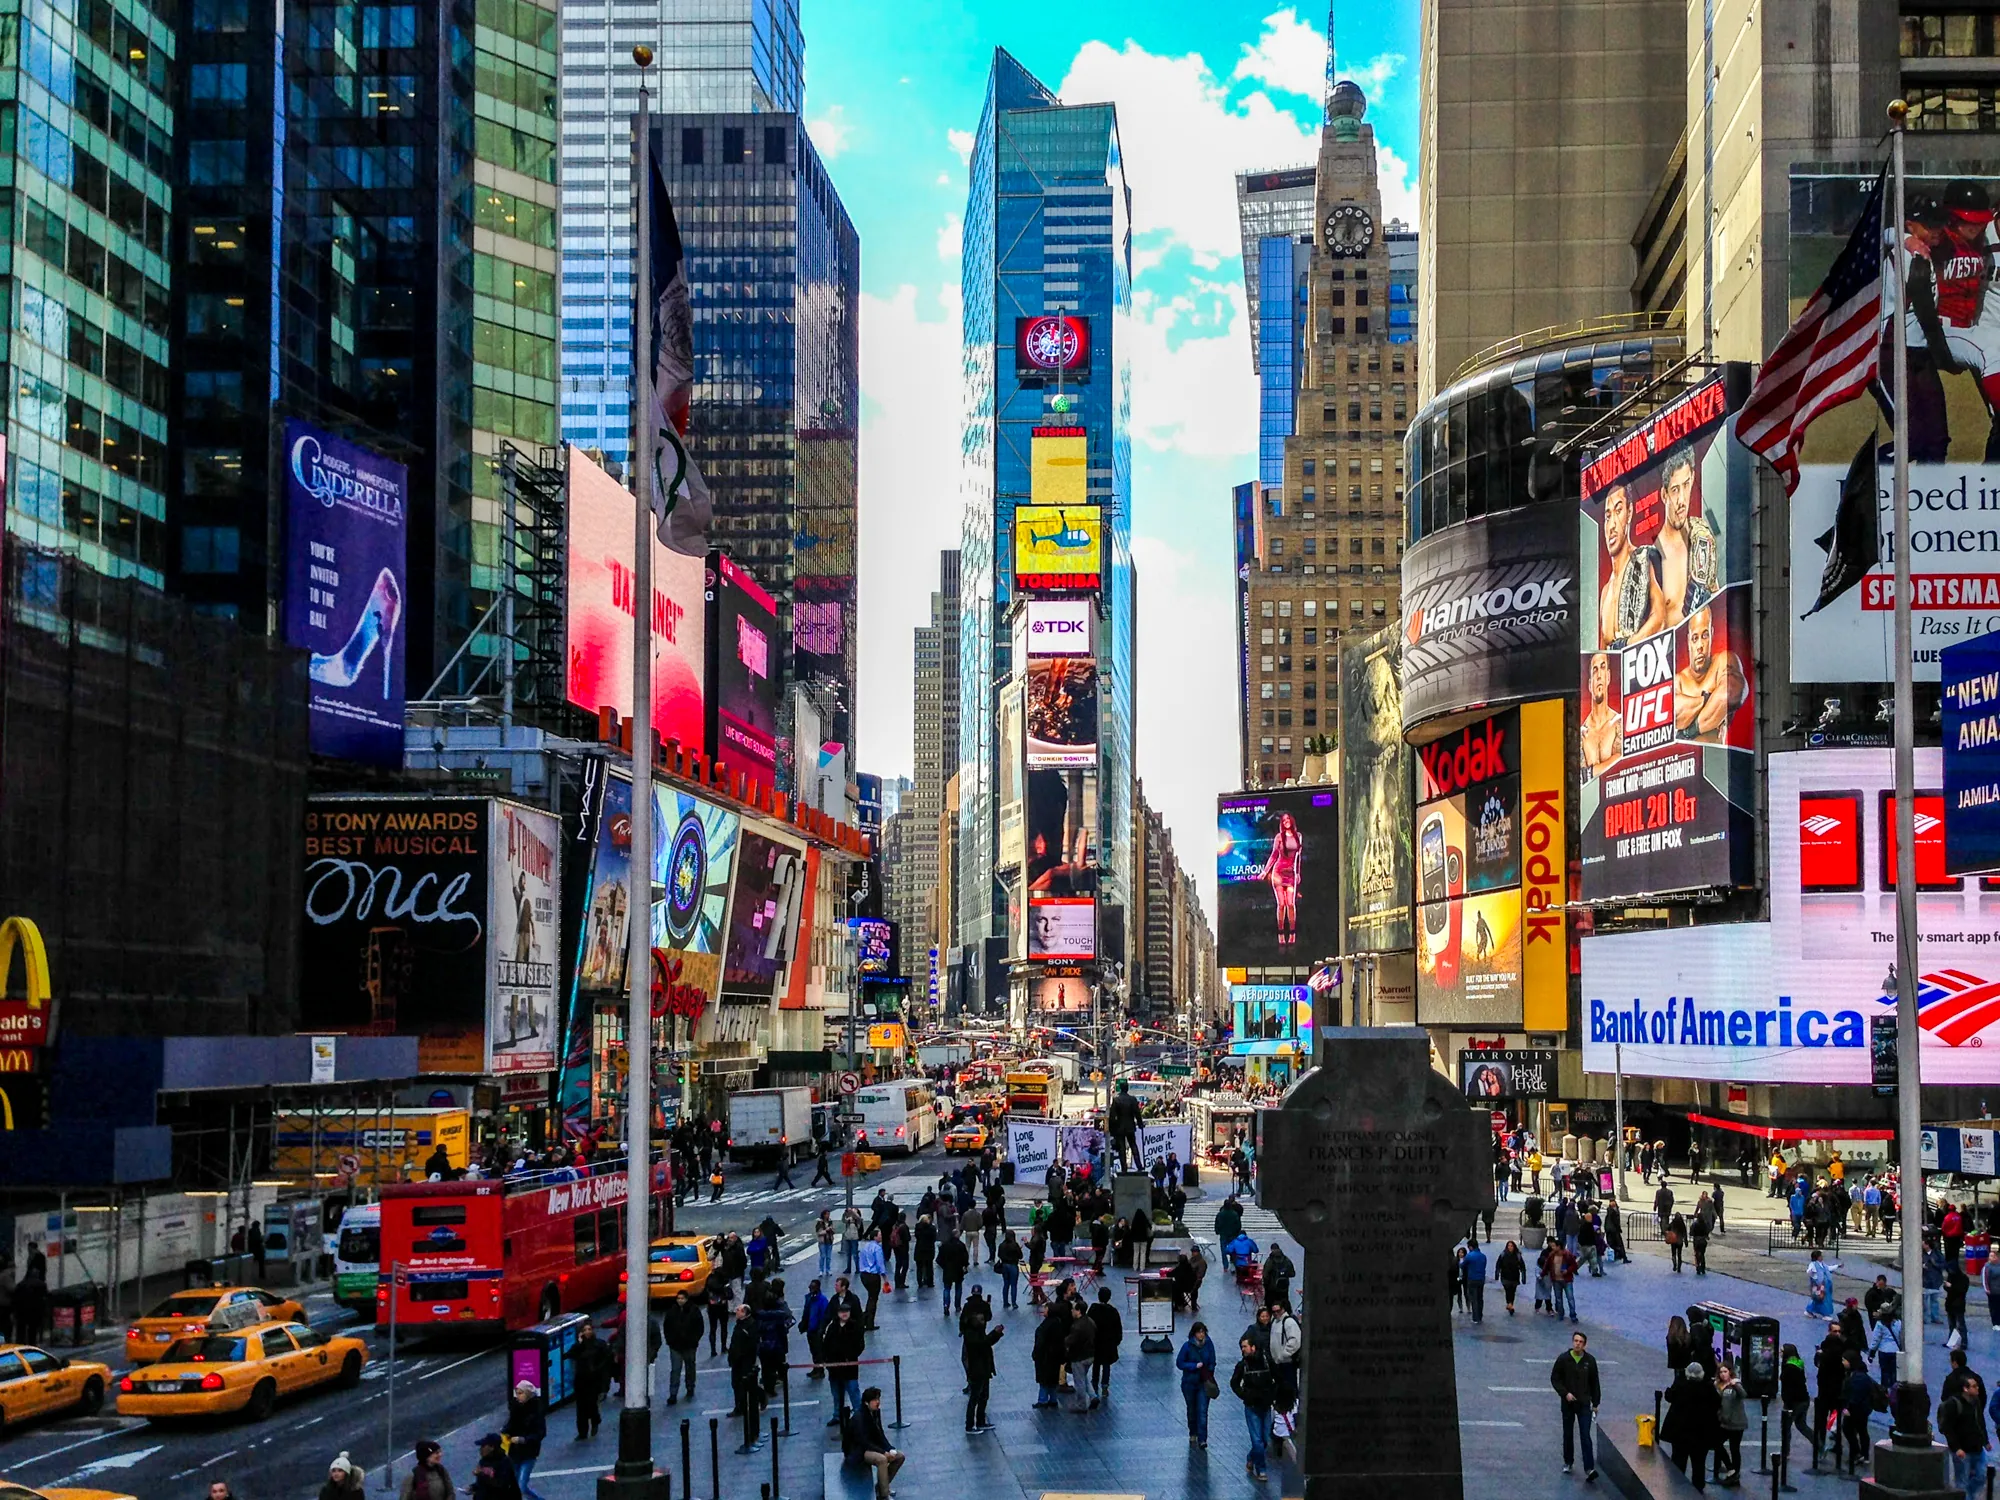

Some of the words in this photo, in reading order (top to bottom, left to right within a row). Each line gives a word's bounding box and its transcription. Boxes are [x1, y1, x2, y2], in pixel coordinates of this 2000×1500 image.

[1032, 427, 1086, 437] TOSHIBA
[291, 435, 403, 521] CINDERELLA
[310, 564, 339, 587] INVITED
[1015, 574, 1099, 589] TOSHIBA
[310, 587, 320, 605] TO
[309, 610, 327, 631] BALL
[1049, 620, 1084, 633] TDK
[1437, 621, 1485, 644] driving
[1487, 609, 1568, 631] emotion
[1919, 615, 1961, 636] Pass
[1964, 616, 1981, 635] It
[1624, 633, 1673, 695] FOX
[1625, 684, 1672, 733] UFC
[1623, 725, 1673, 754] SATURDAY
[1421, 717, 1508, 801] Kodak
[1657, 754, 1679, 766] BATTLE
[1606, 777, 1626, 799] FRANK
[1642, 767, 1664, 789] DANIEL
[1665, 758, 1696, 783] CORMIER
[323, 813, 382, 831] TONY
[384, 812, 479, 831] AWARDS
[1605, 798, 1645, 839] APRIL
[1647, 792, 1667, 830] 20
[306, 837, 366, 856] BEST
[375, 837, 479, 855] MUSICAL
[1616, 839, 1631, 859] LIVE
[1636, 834, 1650, 855] FREE
[1650, 832, 1661, 852] ON
[1662, 827, 1683, 850] FOX
[1225, 864, 1265, 876] SHARON
[1523, 789, 1561, 947] Kodak
[1870, 932, 1894, 943] The
[1926, 933, 1965, 944] smart
[1967, 934, 1992, 948] app
[498, 961, 553, 987] NEWSIES
[1590, 998, 1647, 1044] Bank
[1652, 996, 1678, 1045] of
[1681, 996, 1866, 1048] America
[1464, 1051, 1552, 1060] MARQUIS
[1162, 1066, 1187, 1074] Broadway
[1511, 1063, 1542, 1081] Jekyll
[1515, 1076, 1548, 1094] Hyde
[1014, 1130, 1034, 1142] Long
[1144, 1132, 1166, 1146] Wear
[1167, 1128, 1177, 1139] it.
[1016, 1141, 1030, 1153] live
[1143, 1145, 1163, 1158] Love
[1164, 1140, 1175, 1151] it.
[1309, 1145, 1373, 1161] FRANCIS
[1394, 1145, 1449, 1161] DUFFY
[1017, 1149, 1048, 1165] fashion!
[548, 1189, 570, 1216] New
[571, 1184, 591, 1209] York
[593, 1173, 629, 1209] Sightsee
[438, 1257, 475, 1265] Sightseeing
